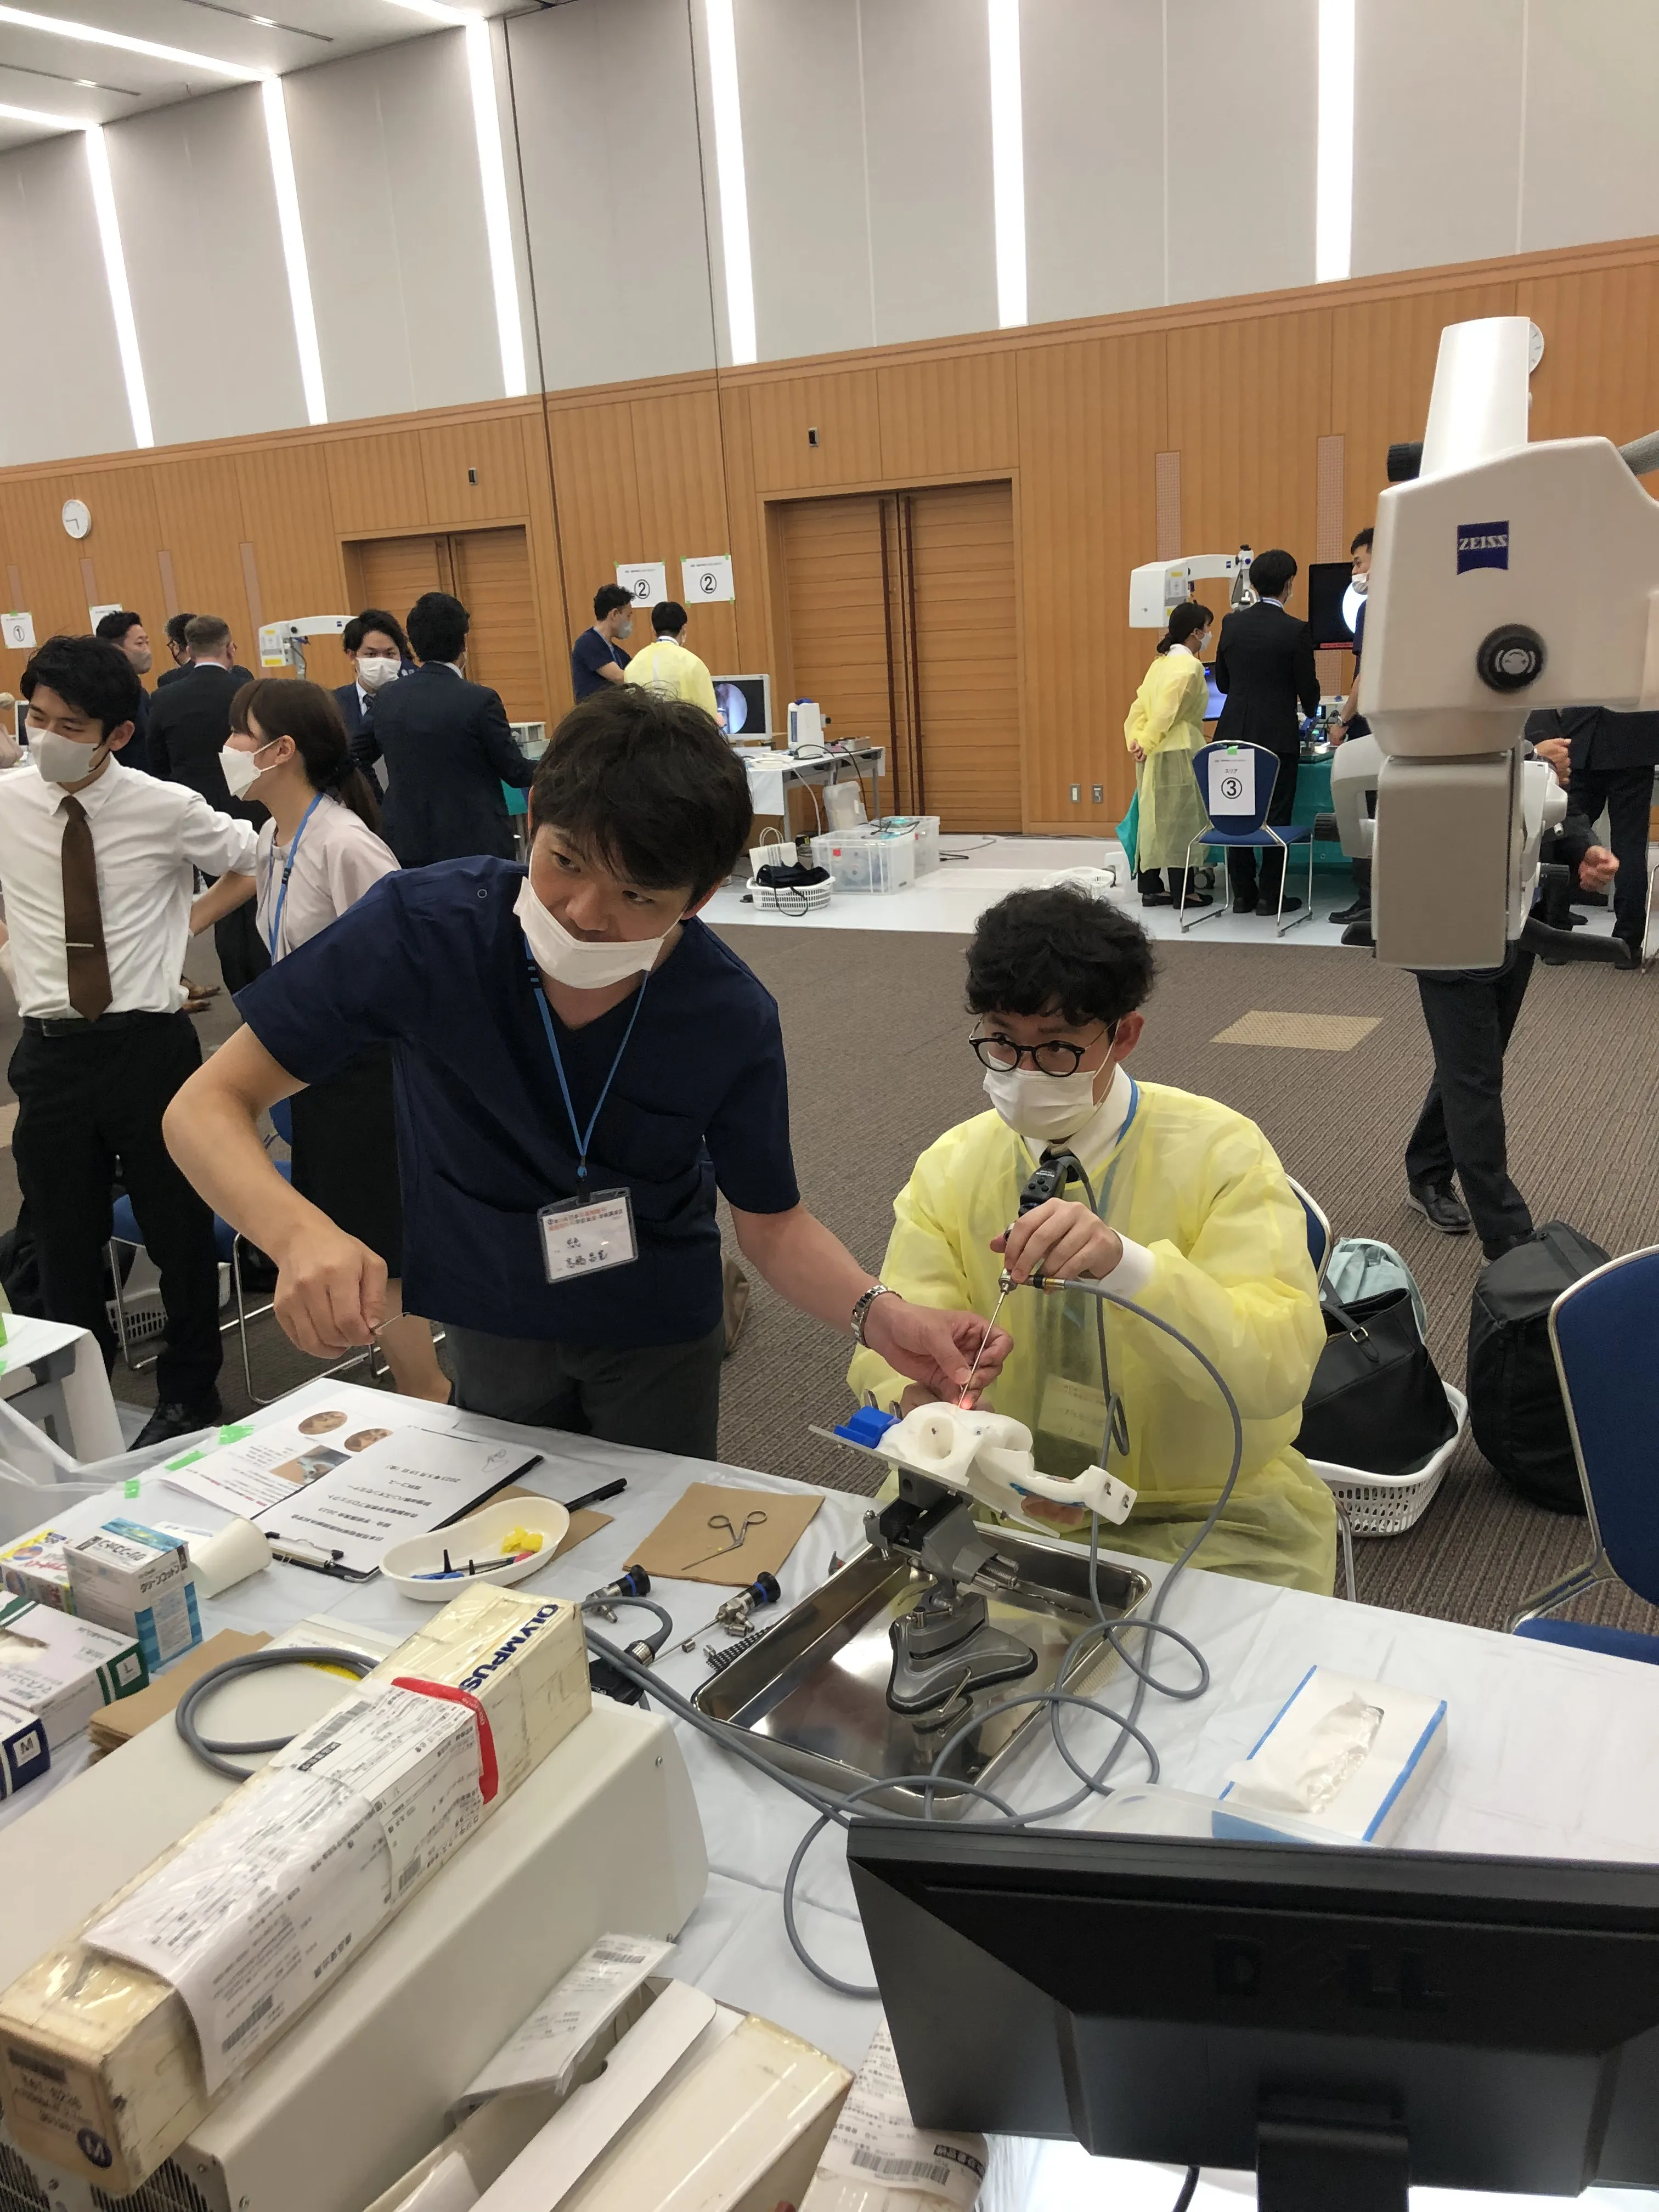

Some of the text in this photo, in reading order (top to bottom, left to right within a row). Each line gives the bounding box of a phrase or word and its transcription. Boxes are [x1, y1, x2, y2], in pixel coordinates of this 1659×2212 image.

[1459, 534, 1508, 551] ZEISS
[459, 1604, 558, 1692] OLYMPUS
[123, 1662, 133, 1674] L
[20, 1737, 33, 1754] M
[1212, 1933, 1449, 2013] DLL
